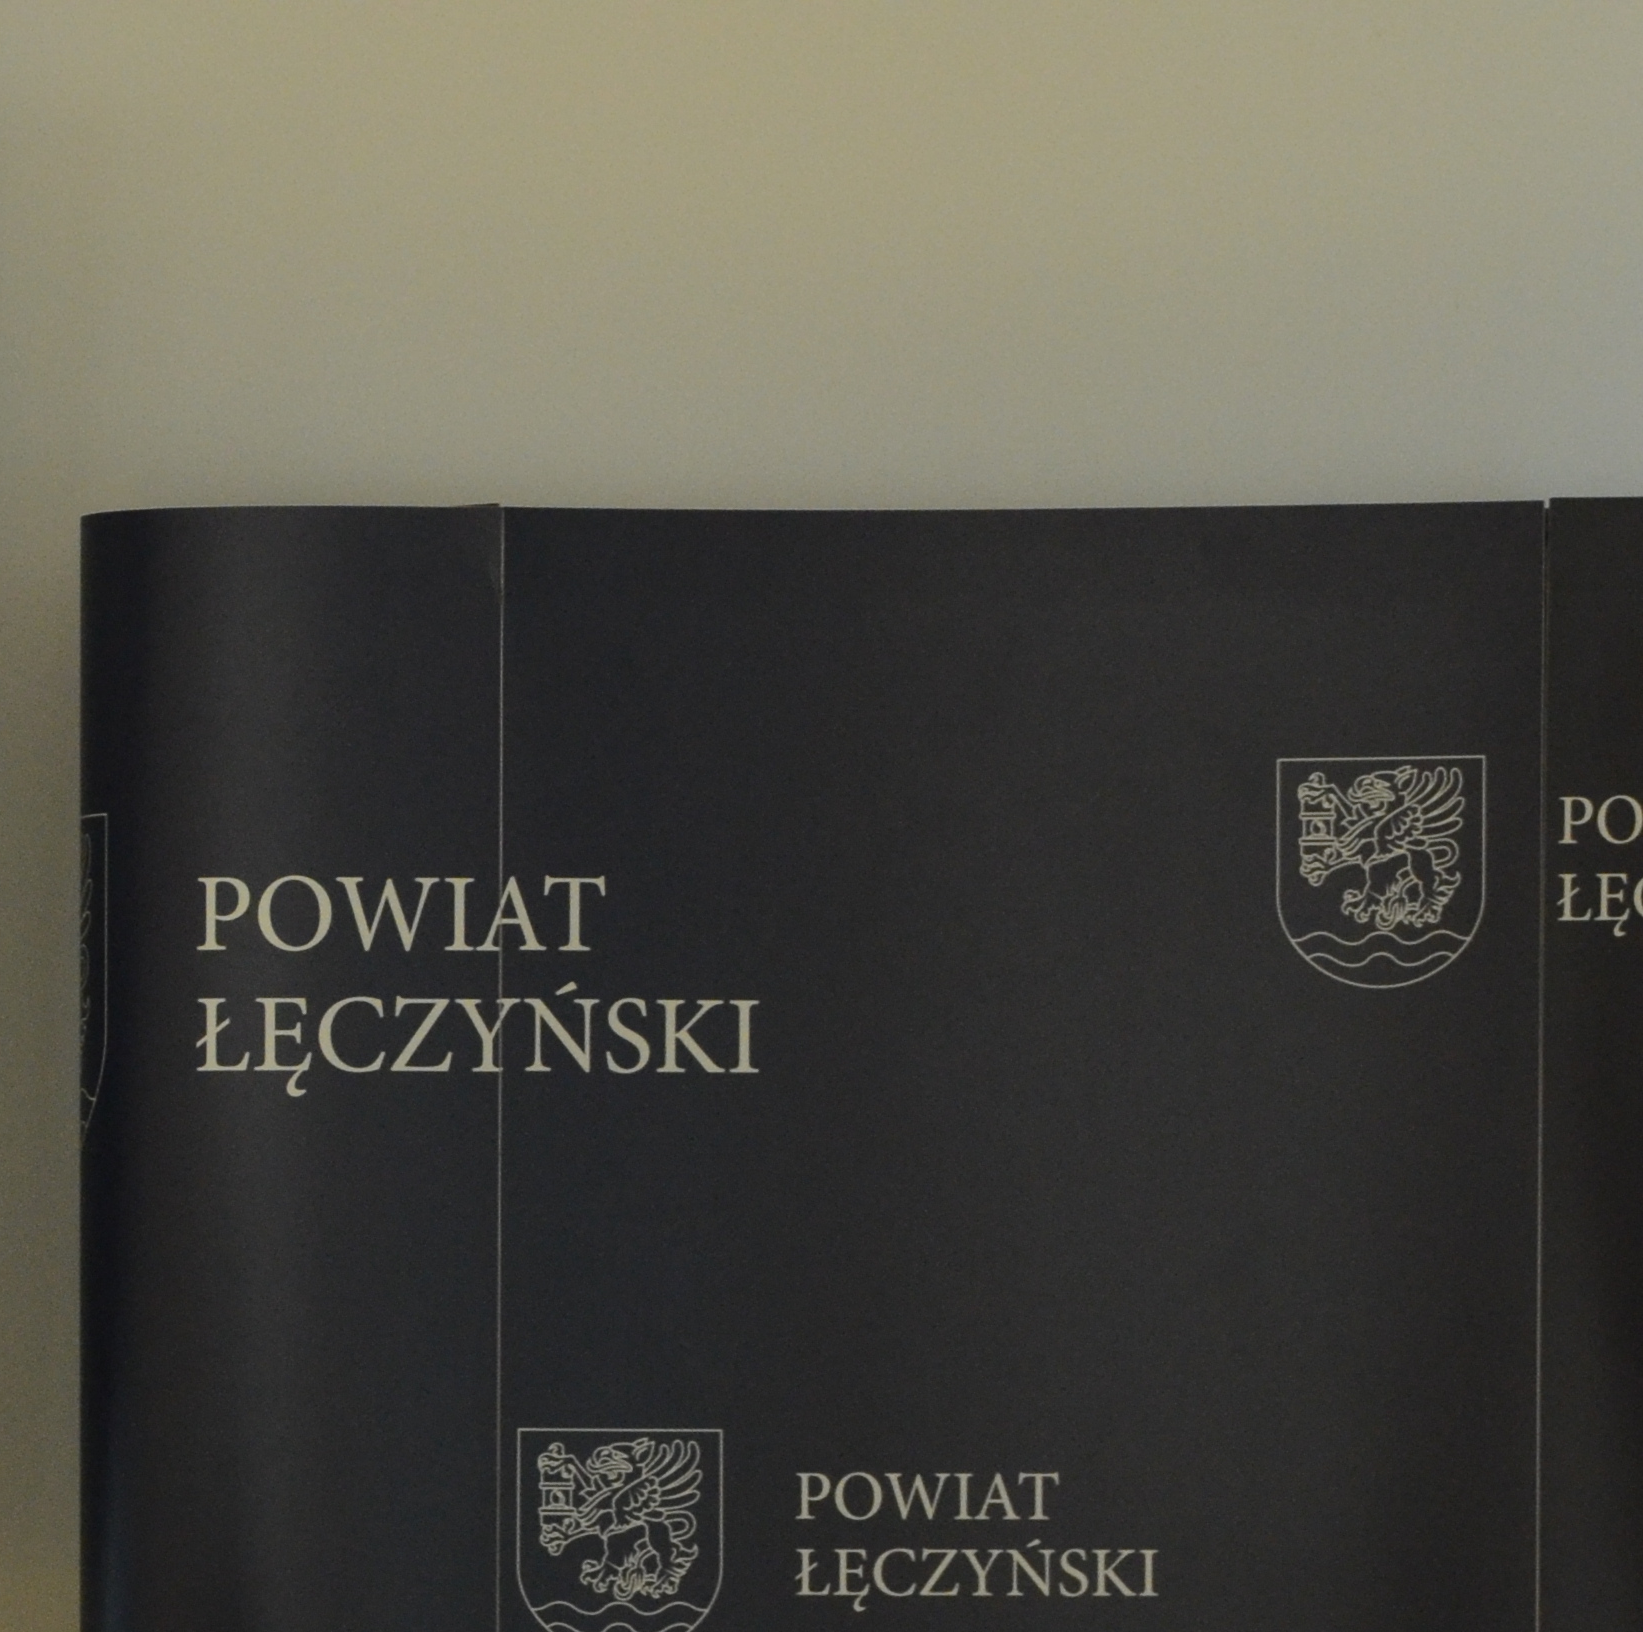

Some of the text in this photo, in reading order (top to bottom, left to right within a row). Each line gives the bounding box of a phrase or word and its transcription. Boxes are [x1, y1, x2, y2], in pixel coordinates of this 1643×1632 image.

[1558, 794, 1643, 845] PO
[196, 874, 606, 952] POWIAT
[1556, 872, 1643, 937] ŁĘ
[195, 981, 760, 1098] ŁĘCZYŃSKI
[795, 1471, 1060, 1521] POWIAT
[795, 1538, 1159, 1613] ŁĘCZYŃSKI
